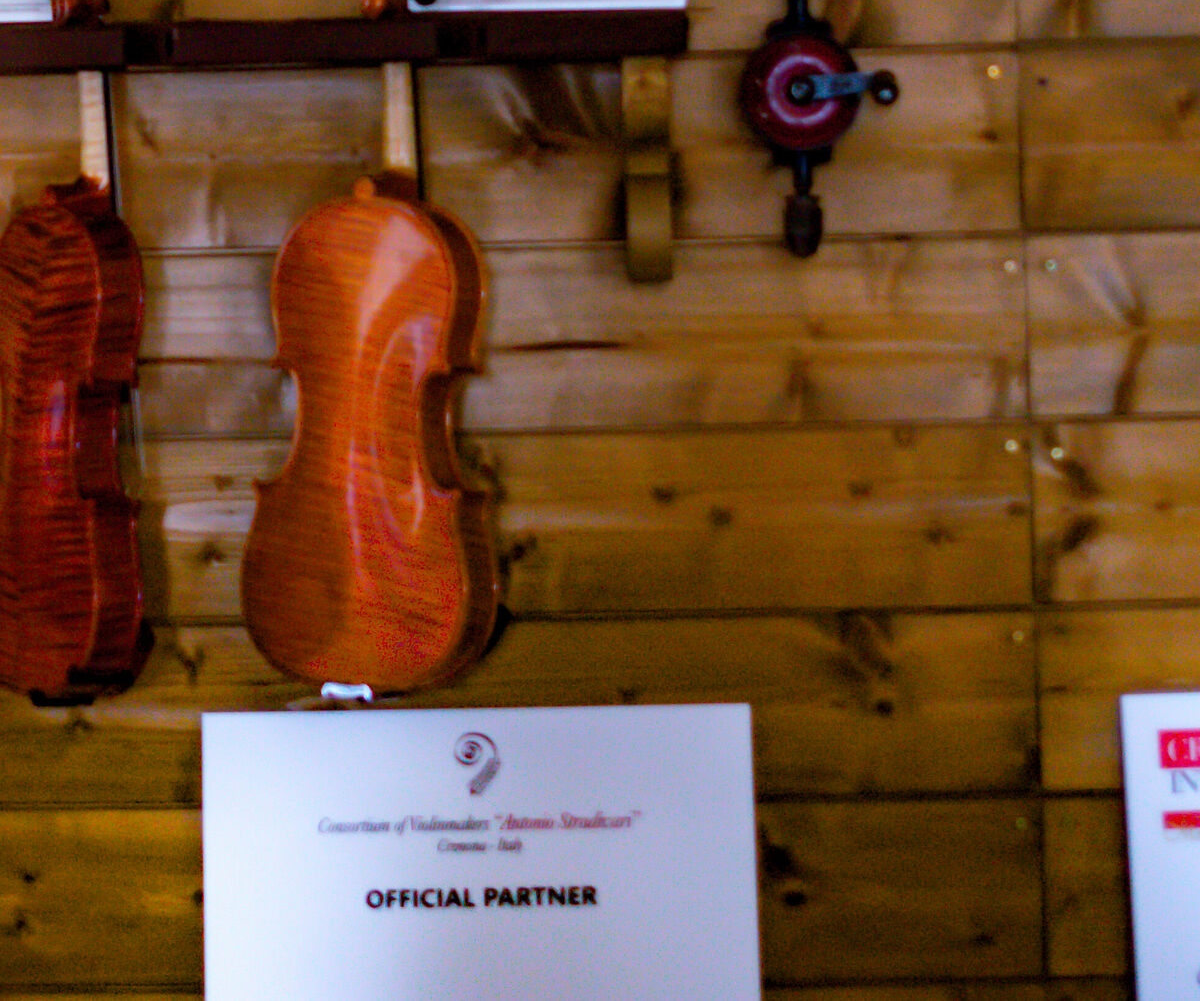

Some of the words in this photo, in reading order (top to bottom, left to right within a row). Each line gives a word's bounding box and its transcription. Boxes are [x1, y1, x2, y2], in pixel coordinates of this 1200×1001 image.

[317, 816, 390, 834] Consortium
[393, 814, 407, 835] of
[437, 837, 488, 855] Cremona
[497, 836, 523, 855] Italy
[366, 887, 475, 909] OFFICIAL
[484, 885, 598, 907] PARTNER
